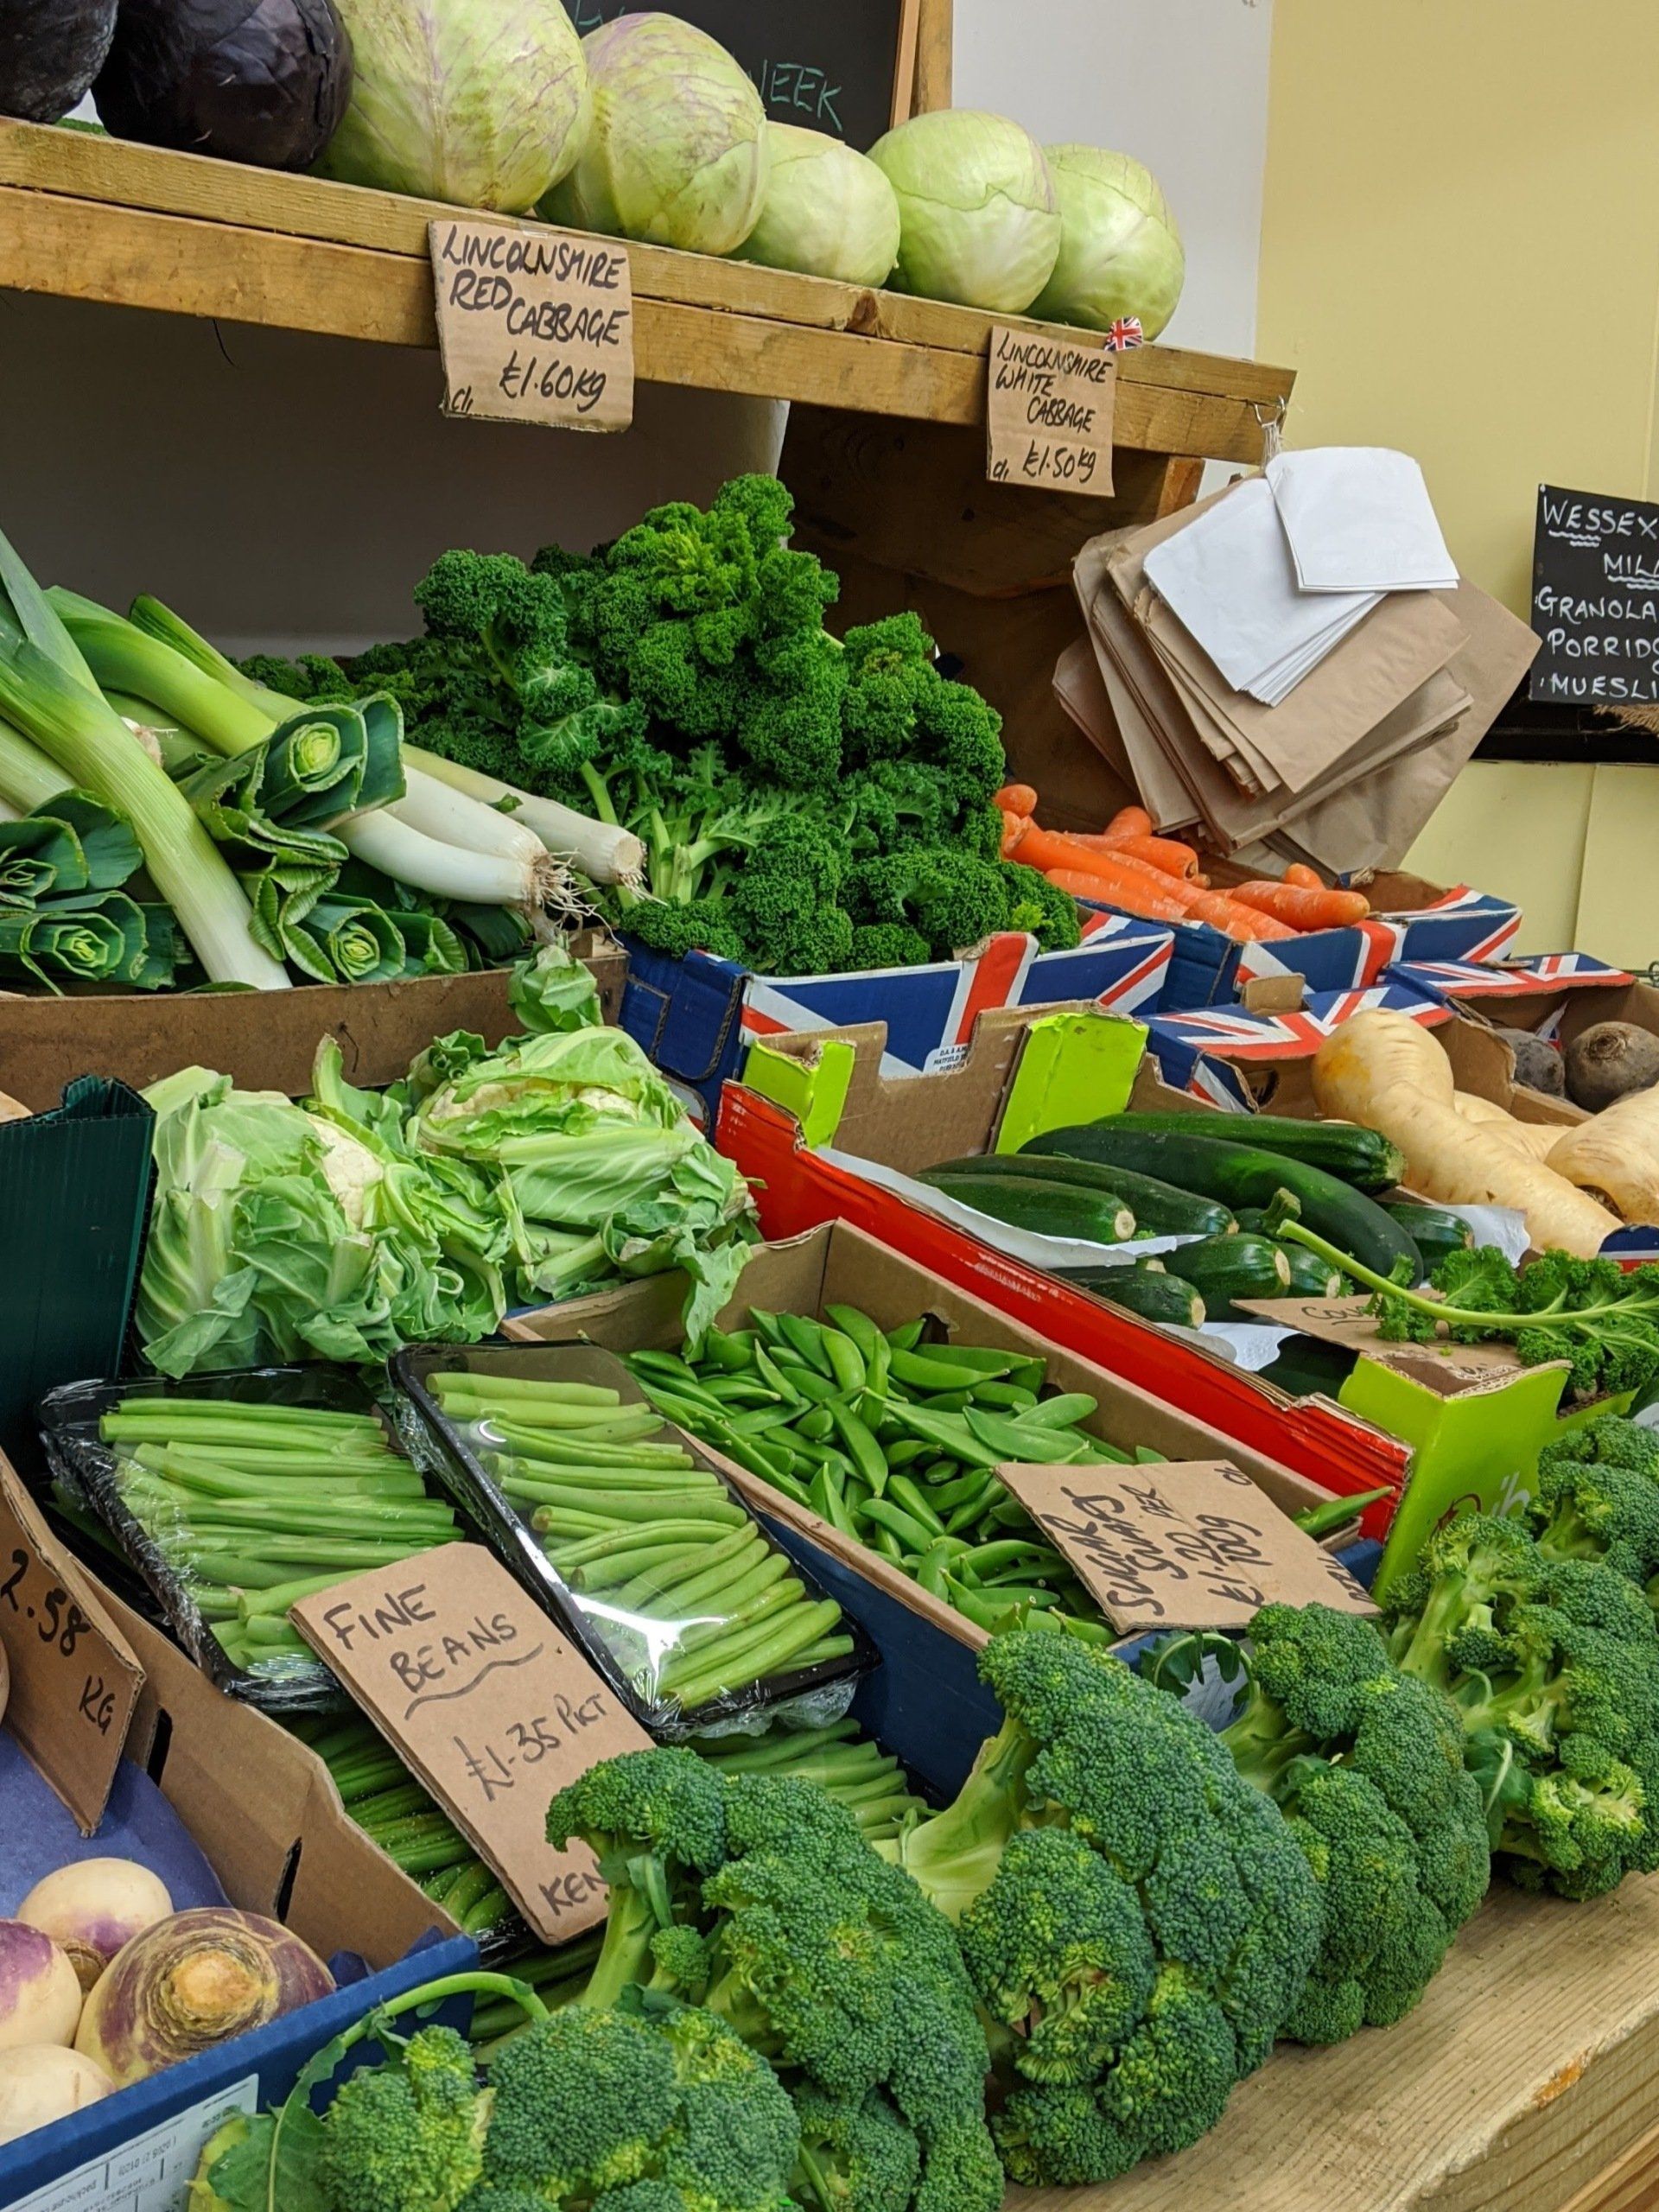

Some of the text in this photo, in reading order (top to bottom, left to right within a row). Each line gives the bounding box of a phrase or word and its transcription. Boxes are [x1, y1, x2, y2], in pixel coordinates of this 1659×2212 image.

[442, 224, 626, 289] LINCOLNSHIRE
[449, 269, 630, 347] RED CABBAGE
[995, 364, 1057, 397] WHITE
[996, 331, 1113, 384] LINCOLNSHIRE
[1027, 395, 1096, 433] CABBAGE
[1543, 495, 1659, 541] WESSEX
[1040, 1513, 1166, 1617] SUGAR
[1060, 1485, 1190, 1580] SNAPS
[1118, 1484, 1267, 1607] £1.20 PER
[322, 1583, 437, 1650] FINE
[389, 1612, 518, 1694] BEANS
